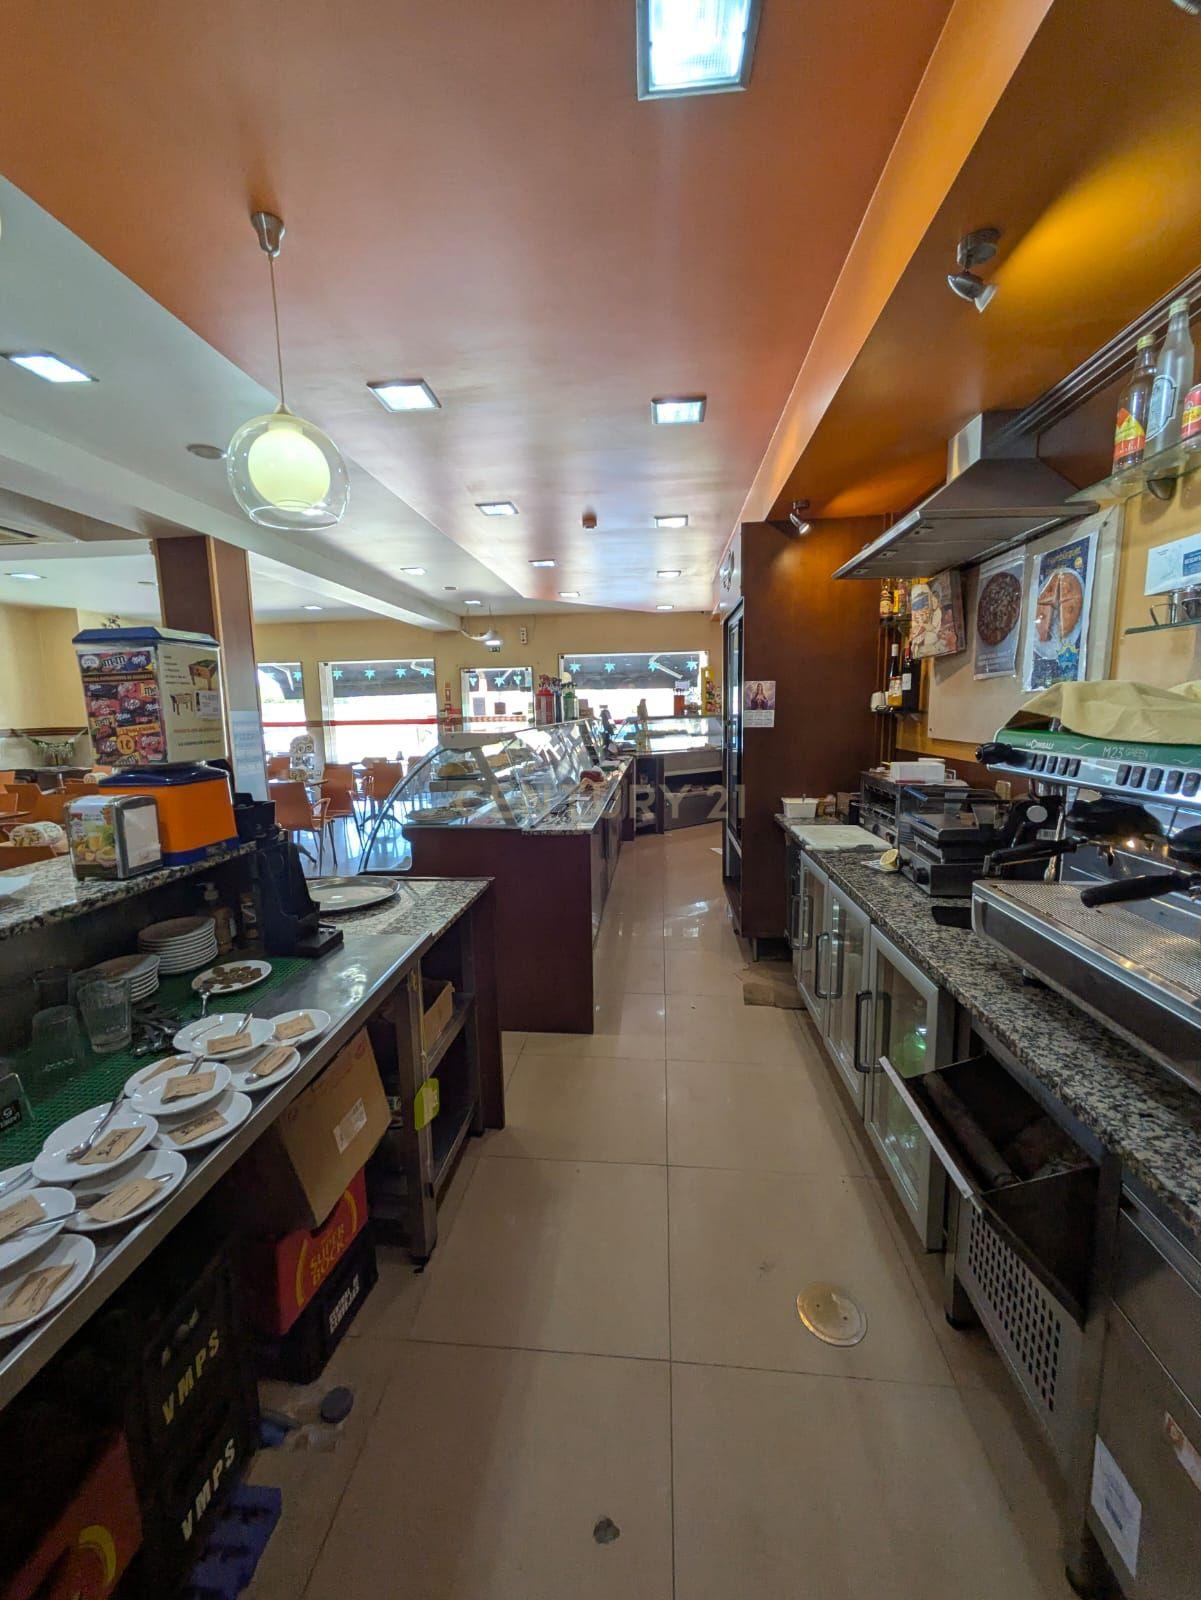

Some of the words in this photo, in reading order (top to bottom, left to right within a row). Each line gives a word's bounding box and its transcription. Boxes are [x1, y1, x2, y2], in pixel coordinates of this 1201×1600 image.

[1103, 746, 1123, 759] M23
[161, 1328, 219, 1425] VMPS
[181, 1438, 235, 1542] VMPS
